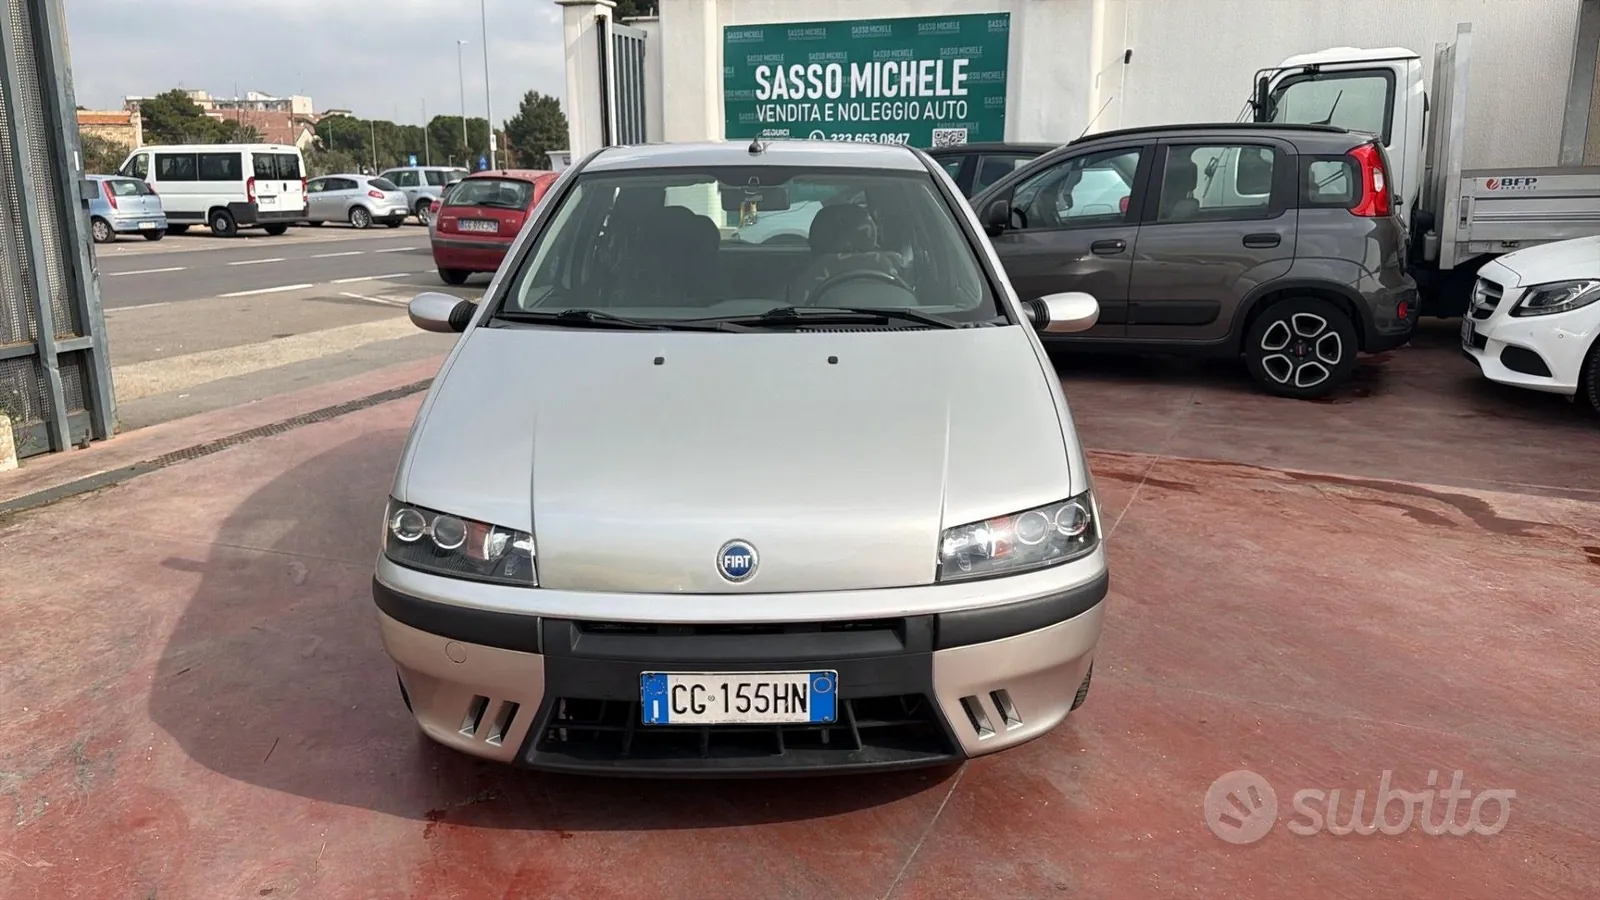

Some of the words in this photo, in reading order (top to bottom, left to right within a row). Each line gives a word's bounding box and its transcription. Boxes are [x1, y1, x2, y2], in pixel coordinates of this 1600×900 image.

[918, 22, 936, 31] SASSO
[937, 22, 960, 30] MICHELE
[756, 62, 842, 100] SASSO
[850, 58, 969, 98] MICHELE
[756, 103, 821, 122] VENDITA
[824, 103, 834, 122] E
[838, 101, 920, 122] NOLEGGIO
[922, 100, 968, 120] AUTO
[1501, 178, 1538, 186] BFP
[724, 555, 750, 568] FIAT
[672, 684, 706, 714] CG
[720, 683, 808, 714] 155HN
